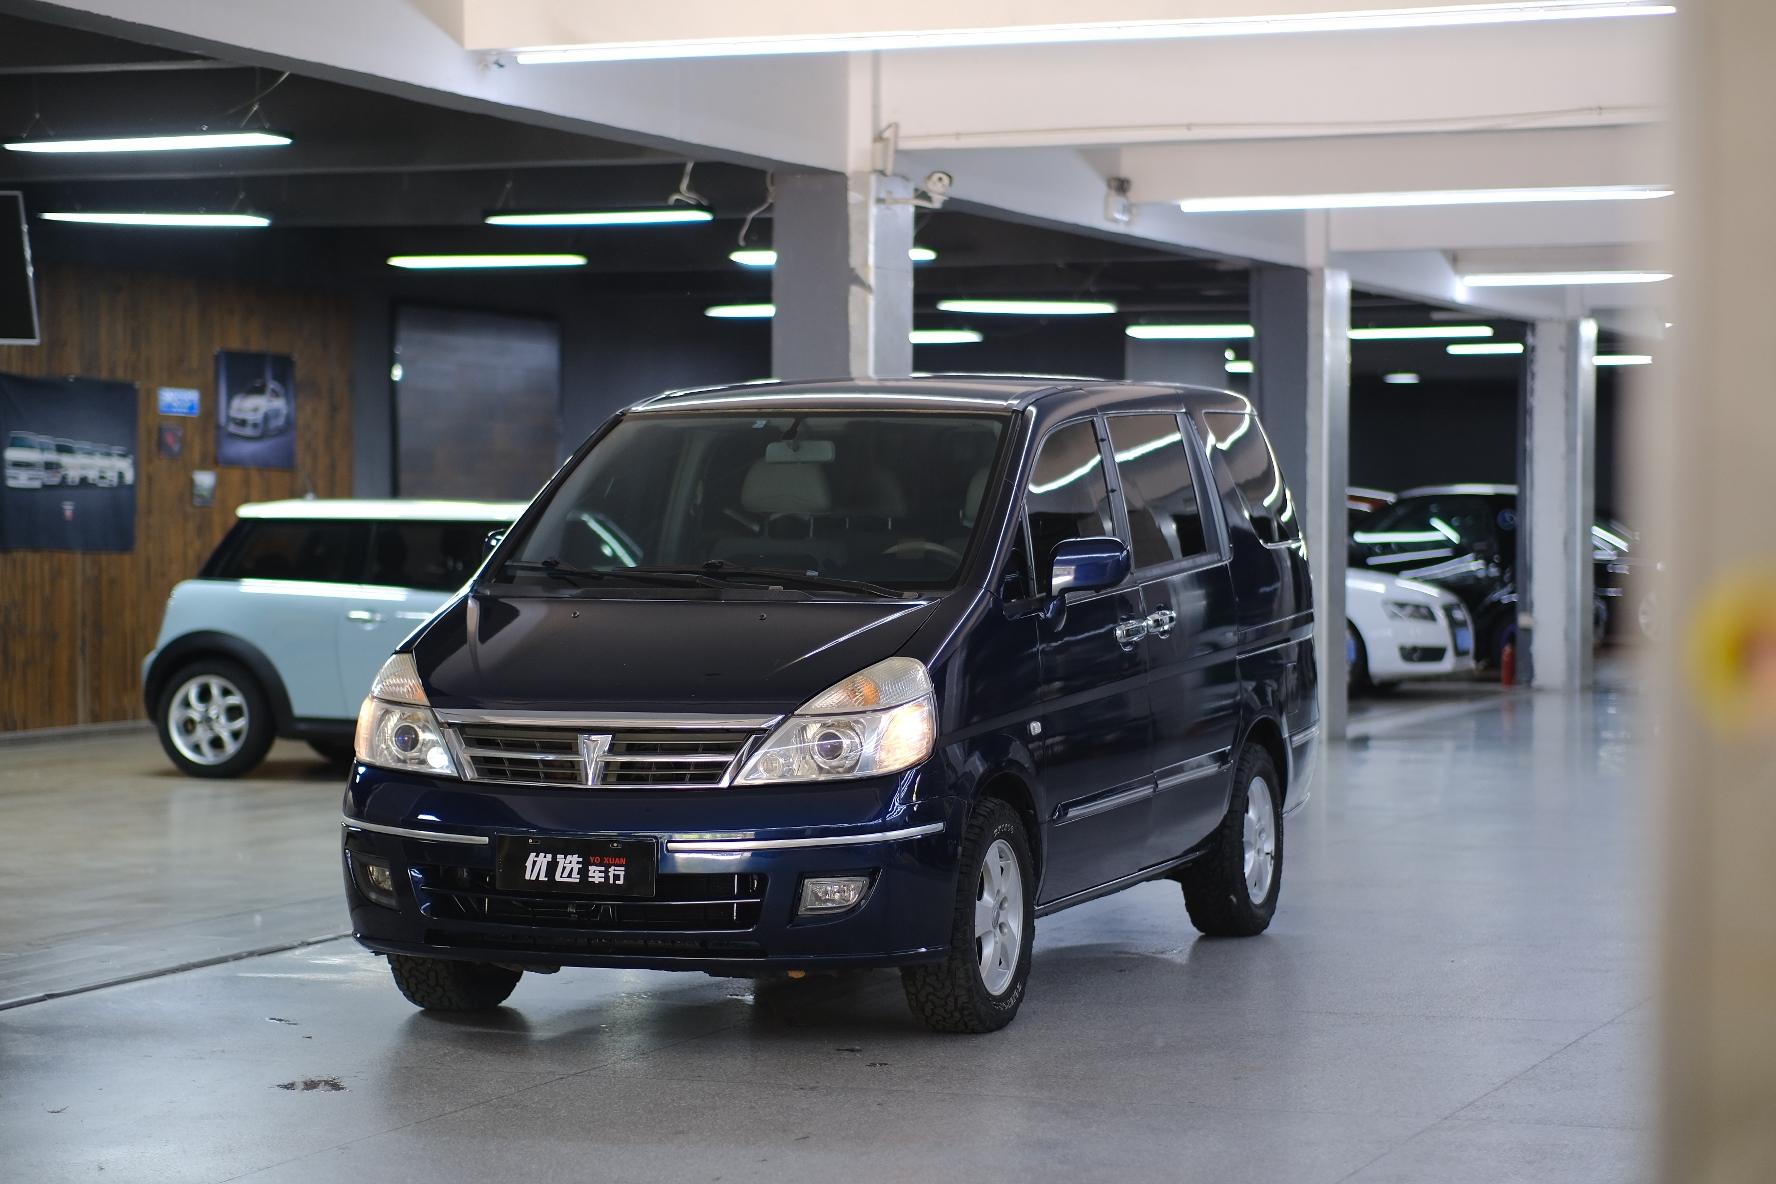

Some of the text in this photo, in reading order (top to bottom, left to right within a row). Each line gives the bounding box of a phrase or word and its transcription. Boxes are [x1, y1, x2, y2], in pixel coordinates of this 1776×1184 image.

[525, 852, 582, 882] 优选
[589, 856, 626, 864] YO XUAN
[588, 865, 625, 884] 车行
